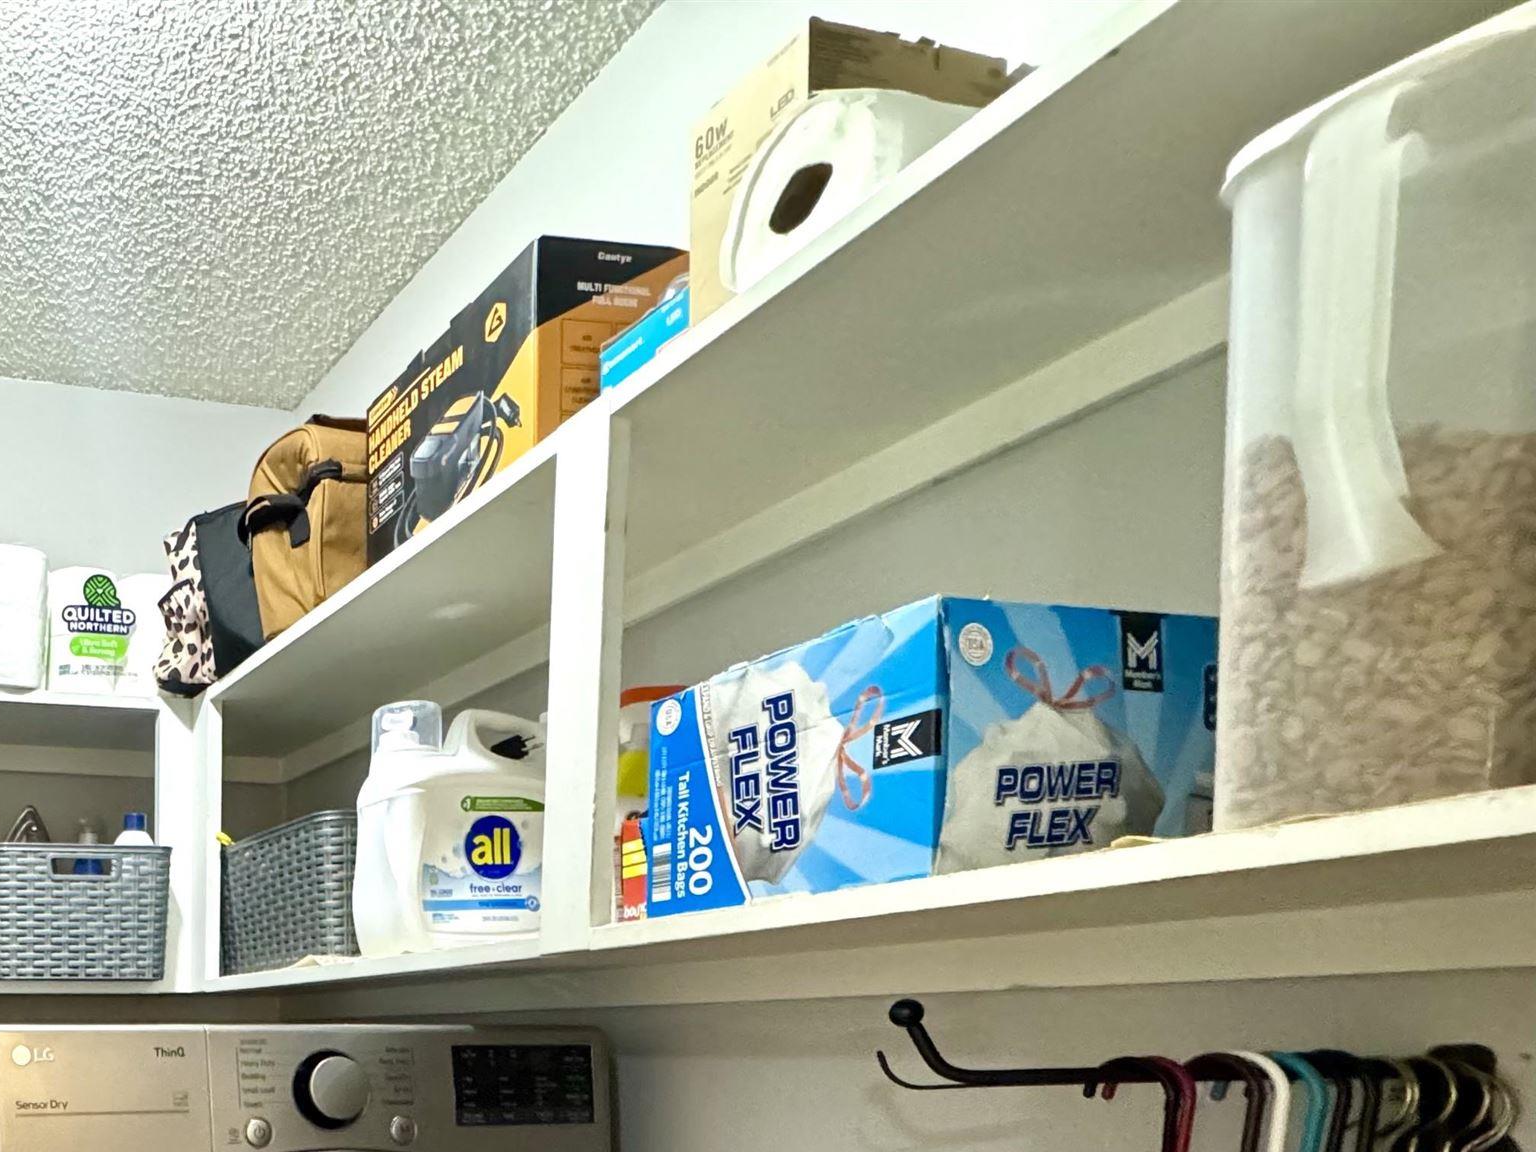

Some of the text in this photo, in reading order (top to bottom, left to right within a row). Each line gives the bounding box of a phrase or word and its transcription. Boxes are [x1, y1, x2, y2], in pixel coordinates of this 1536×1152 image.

[770, 88, 795, 119] LED
[577, 281, 602, 292] MULTI
[368, 388, 418, 454] HANDHELD
[421, 345, 464, 401] STEAM
[368, 419, 412, 475] CLEANER
[63, 606, 135, 624] QUILTED
[69, 621, 128, 633] NORTHERN
[729, 722, 764, 837] FLEX
[763, 689, 802, 851] POWER
[995, 760, 1121, 806] POWER
[471, 828, 511, 866] all
[676, 770, 690, 899] Tall Kitchen Bags
[1005, 806, 1101, 850] FLEX
[688, 825, 714, 896] 200
[469, 883, 522, 894] free clear
[33, 1047, 55, 1062] LG
[154, 1046, 186, 1059] ThinQ
[15, 1099, 69, 1110] Sensor Dry
